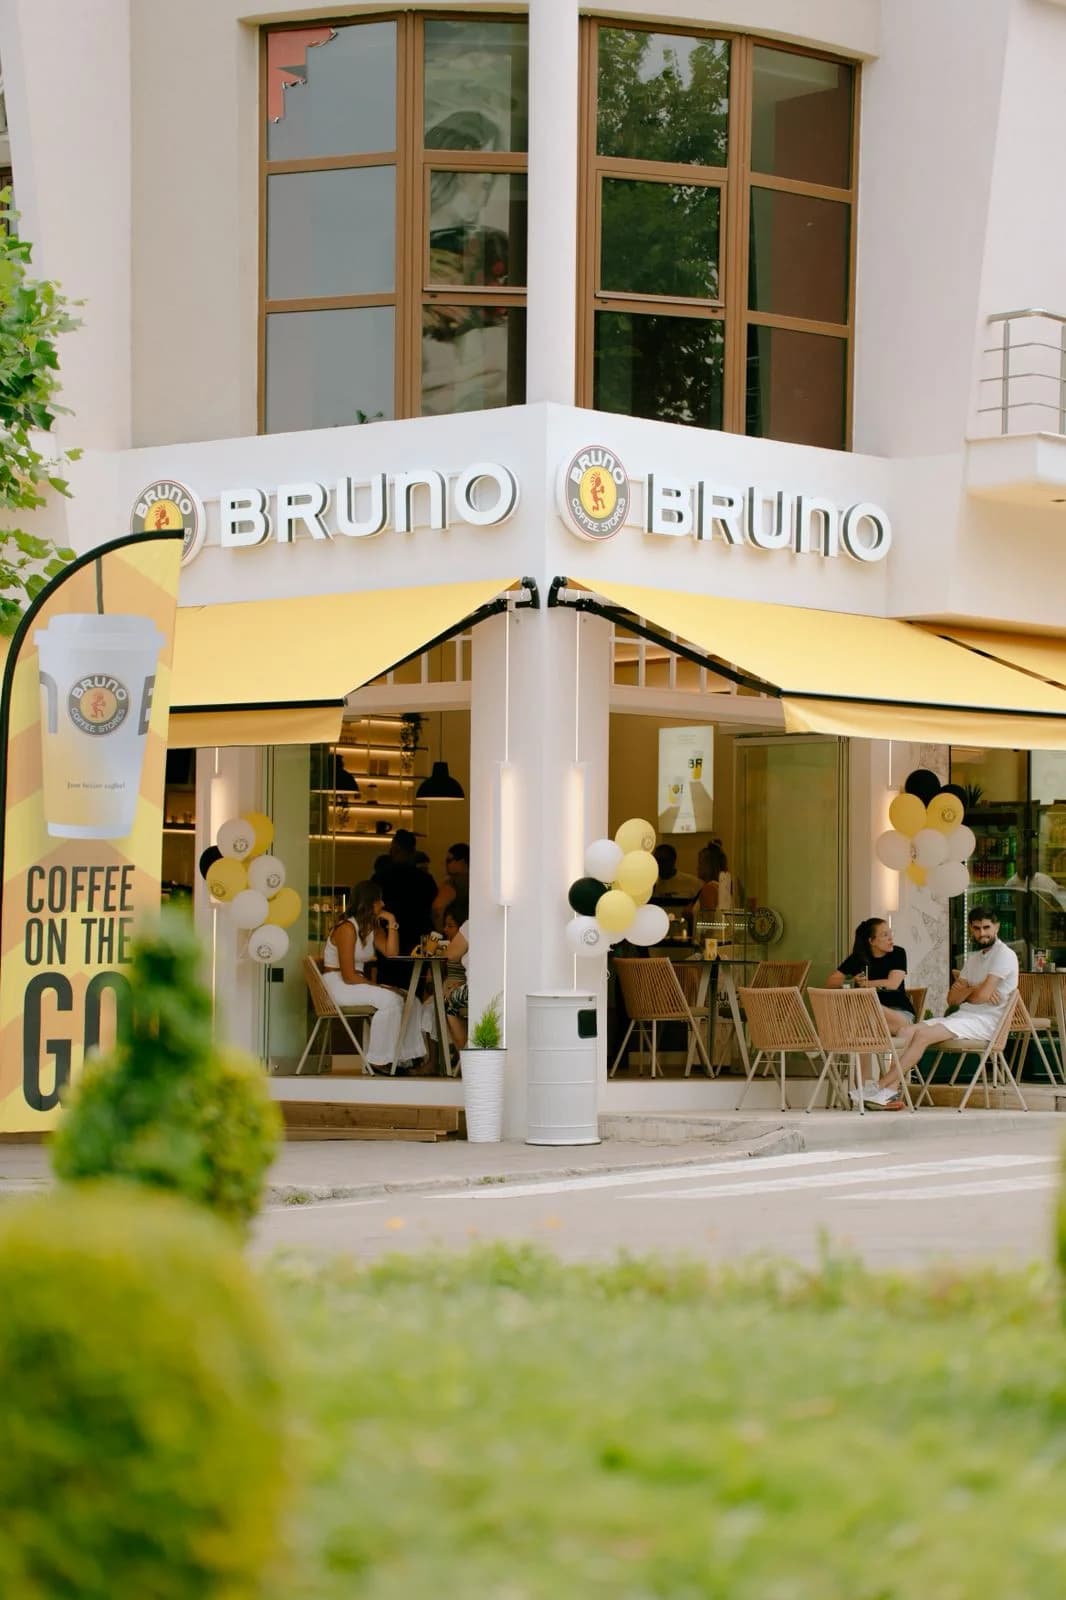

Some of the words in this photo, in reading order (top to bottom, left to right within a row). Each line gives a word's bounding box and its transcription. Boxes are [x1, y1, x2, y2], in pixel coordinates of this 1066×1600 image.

[572, 497, 601, 533] COFFEE
[601, 497, 626, 532] STORES
[71, 706, 97, 733] COFFEE
[26, 865, 136, 914] COFFEE
[24, 917, 68, 966] ON
[81, 917, 134, 965] THE
